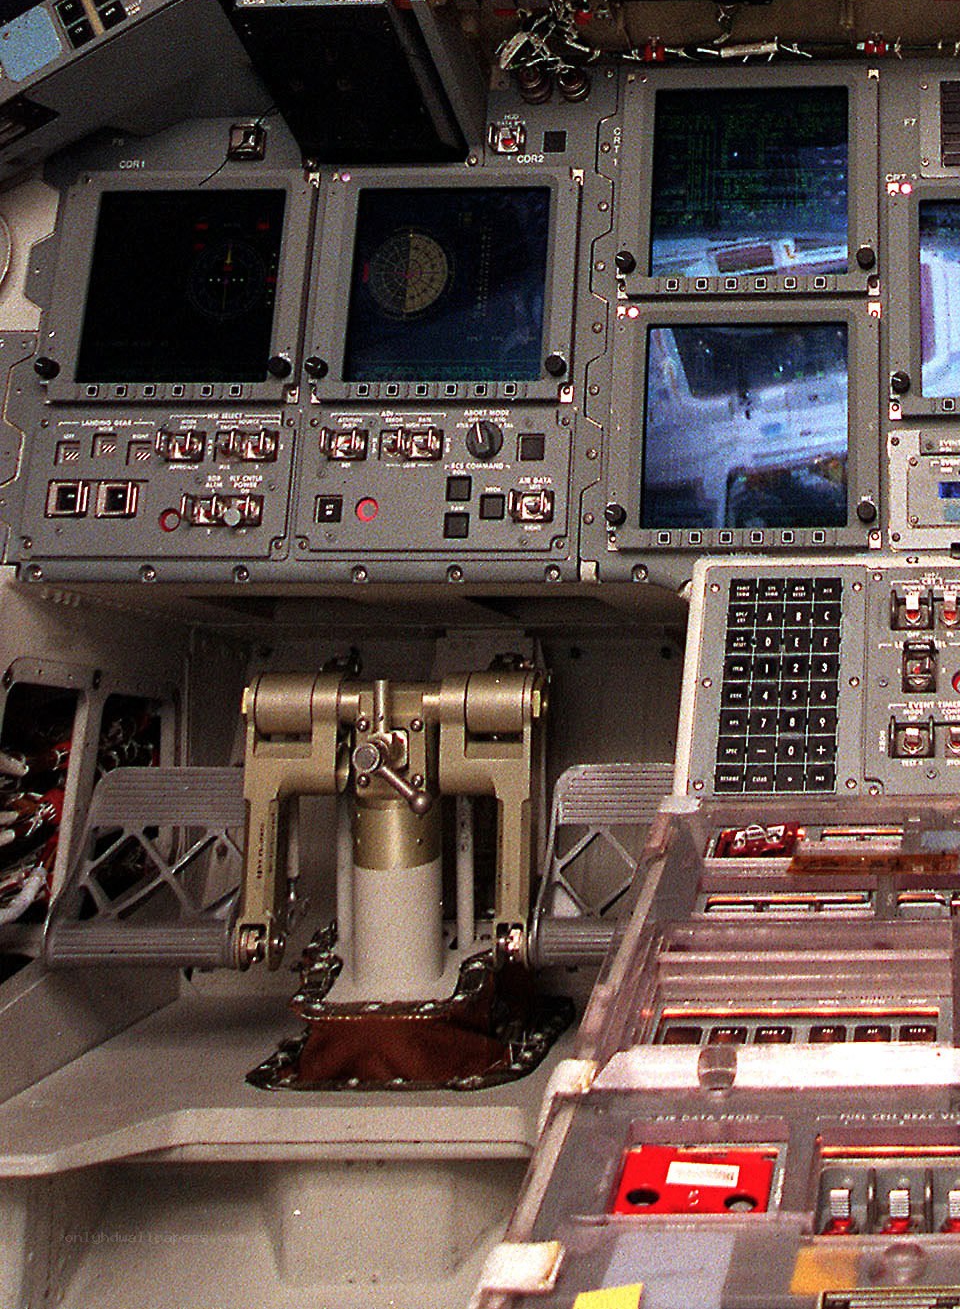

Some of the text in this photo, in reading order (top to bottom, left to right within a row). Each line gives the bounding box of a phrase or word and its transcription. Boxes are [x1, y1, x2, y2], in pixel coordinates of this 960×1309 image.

[766, 612, 773, 621] A
[795, 612, 801, 621] B
[824, 611, 830, 621] C
[794, 637, 800, 647] E
[823, 637, 829, 647] F
[792, 663, 799, 673] 2
[821, 663, 828, 673] 3
[762, 690, 769, 700] 4
[791, 690, 798, 701] 5
[820, 690, 827, 700] 6
[761, 717, 767, 728] 7
[789, 717, 796, 727] 8
[819, 717, 826, 728] 9
